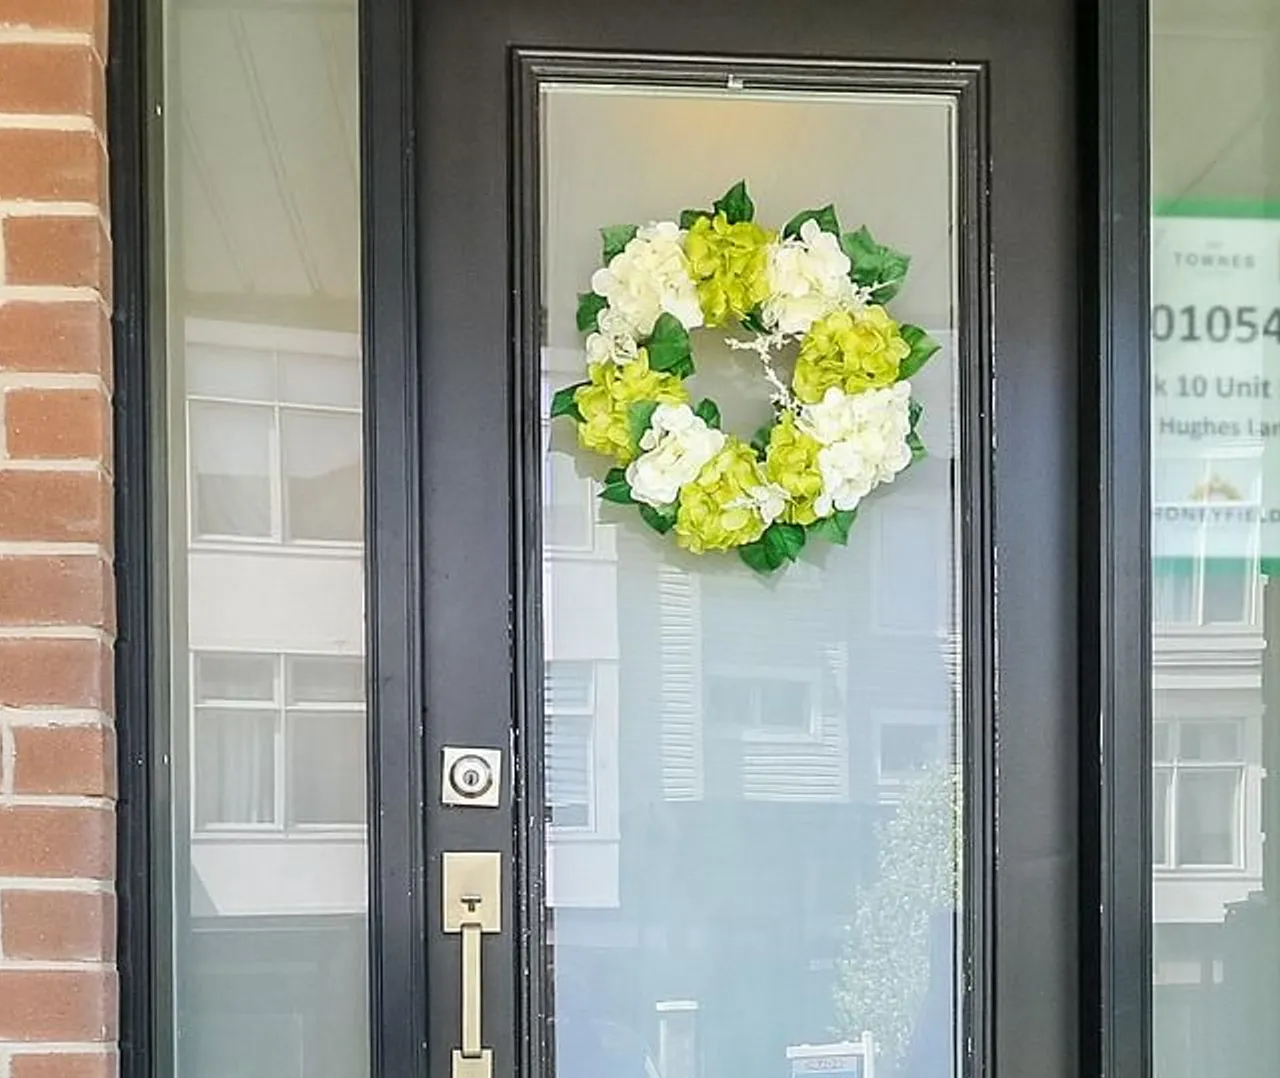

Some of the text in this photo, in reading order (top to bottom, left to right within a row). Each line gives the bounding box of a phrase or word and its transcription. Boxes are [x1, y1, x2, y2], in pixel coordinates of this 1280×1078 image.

[1177, 375, 1208, 398] 10
[1216, 376, 1271, 398] Unit
[1159, 416, 1241, 441] Hughes
